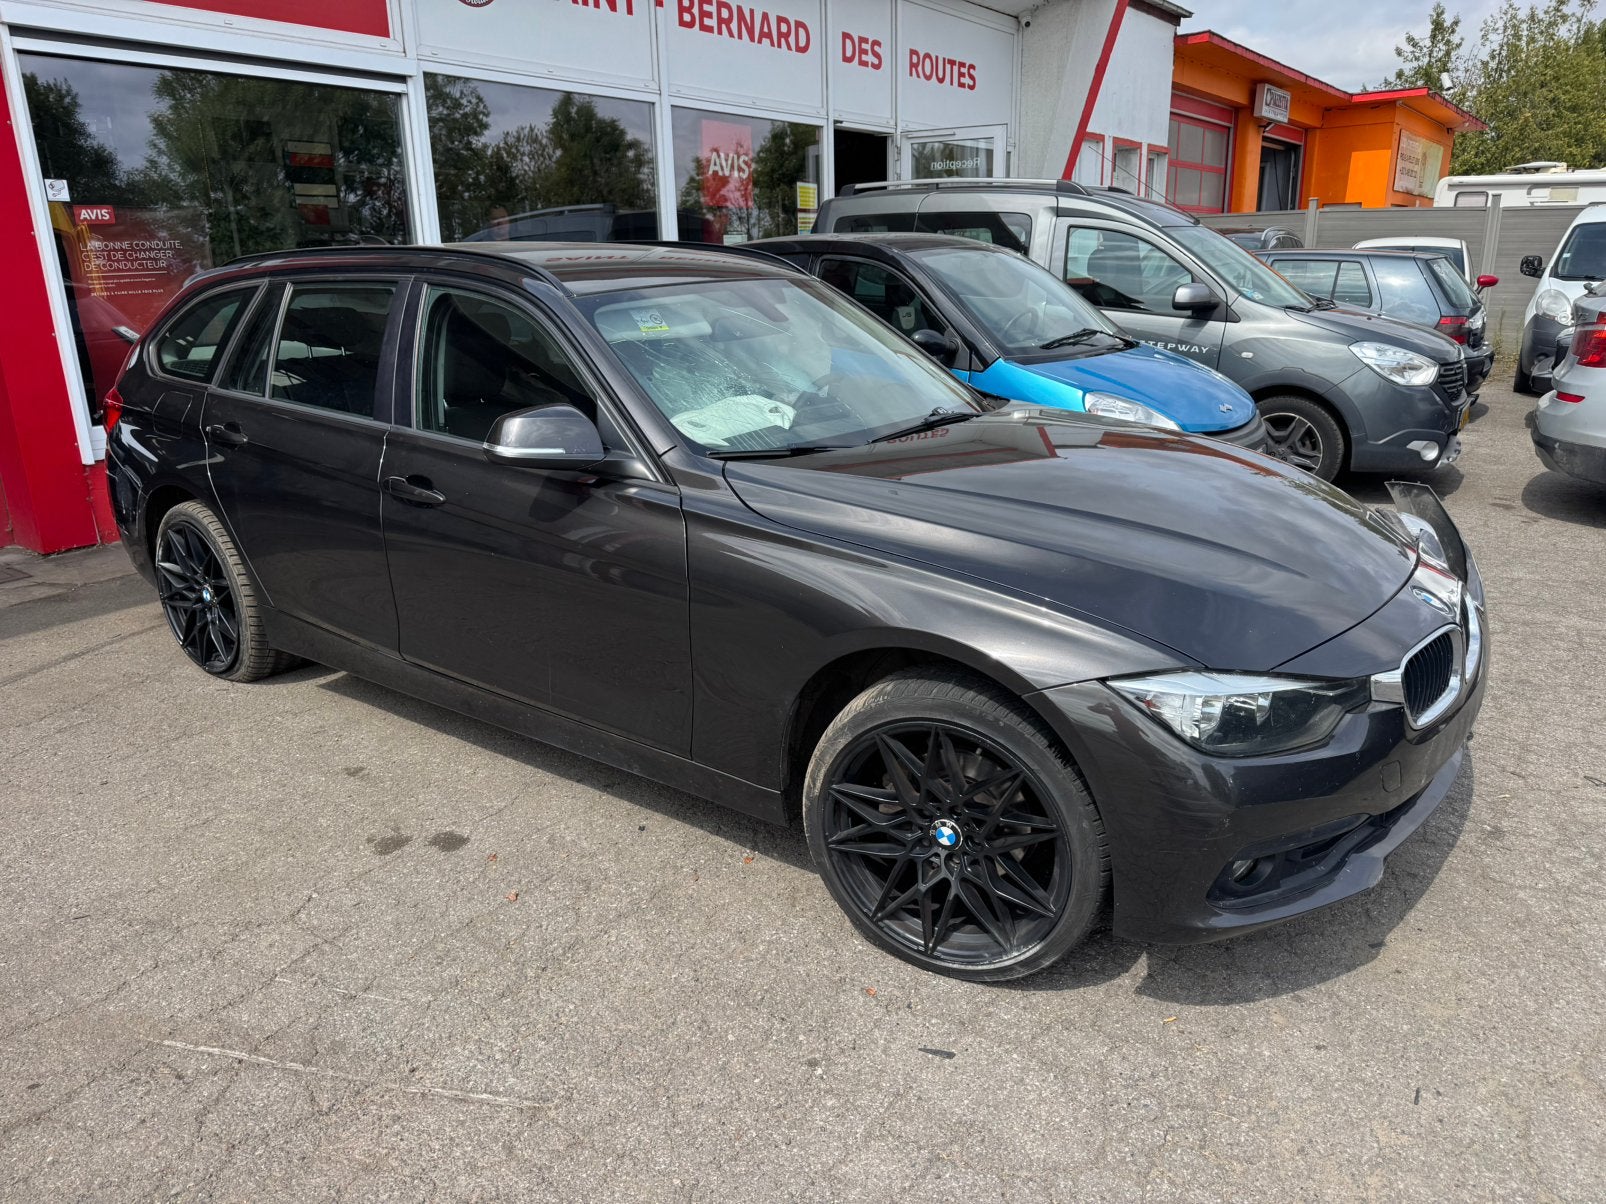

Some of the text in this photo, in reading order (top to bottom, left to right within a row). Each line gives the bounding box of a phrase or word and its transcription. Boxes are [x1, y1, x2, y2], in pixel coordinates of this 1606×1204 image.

[677, 0, 976, 91] BERNARD DES ROUTES
[708, 151, 749, 179] AVIS
[80, 209, 111, 220] AVIS
[80, 240, 183, 251] LA BONNE CONDUITE,
[82, 250, 174, 261] C'EST DE CHANGER
[84, 260, 167, 271] DE CONDUCTEUR
[1140, 340, 1209, 354] TEPWAY
